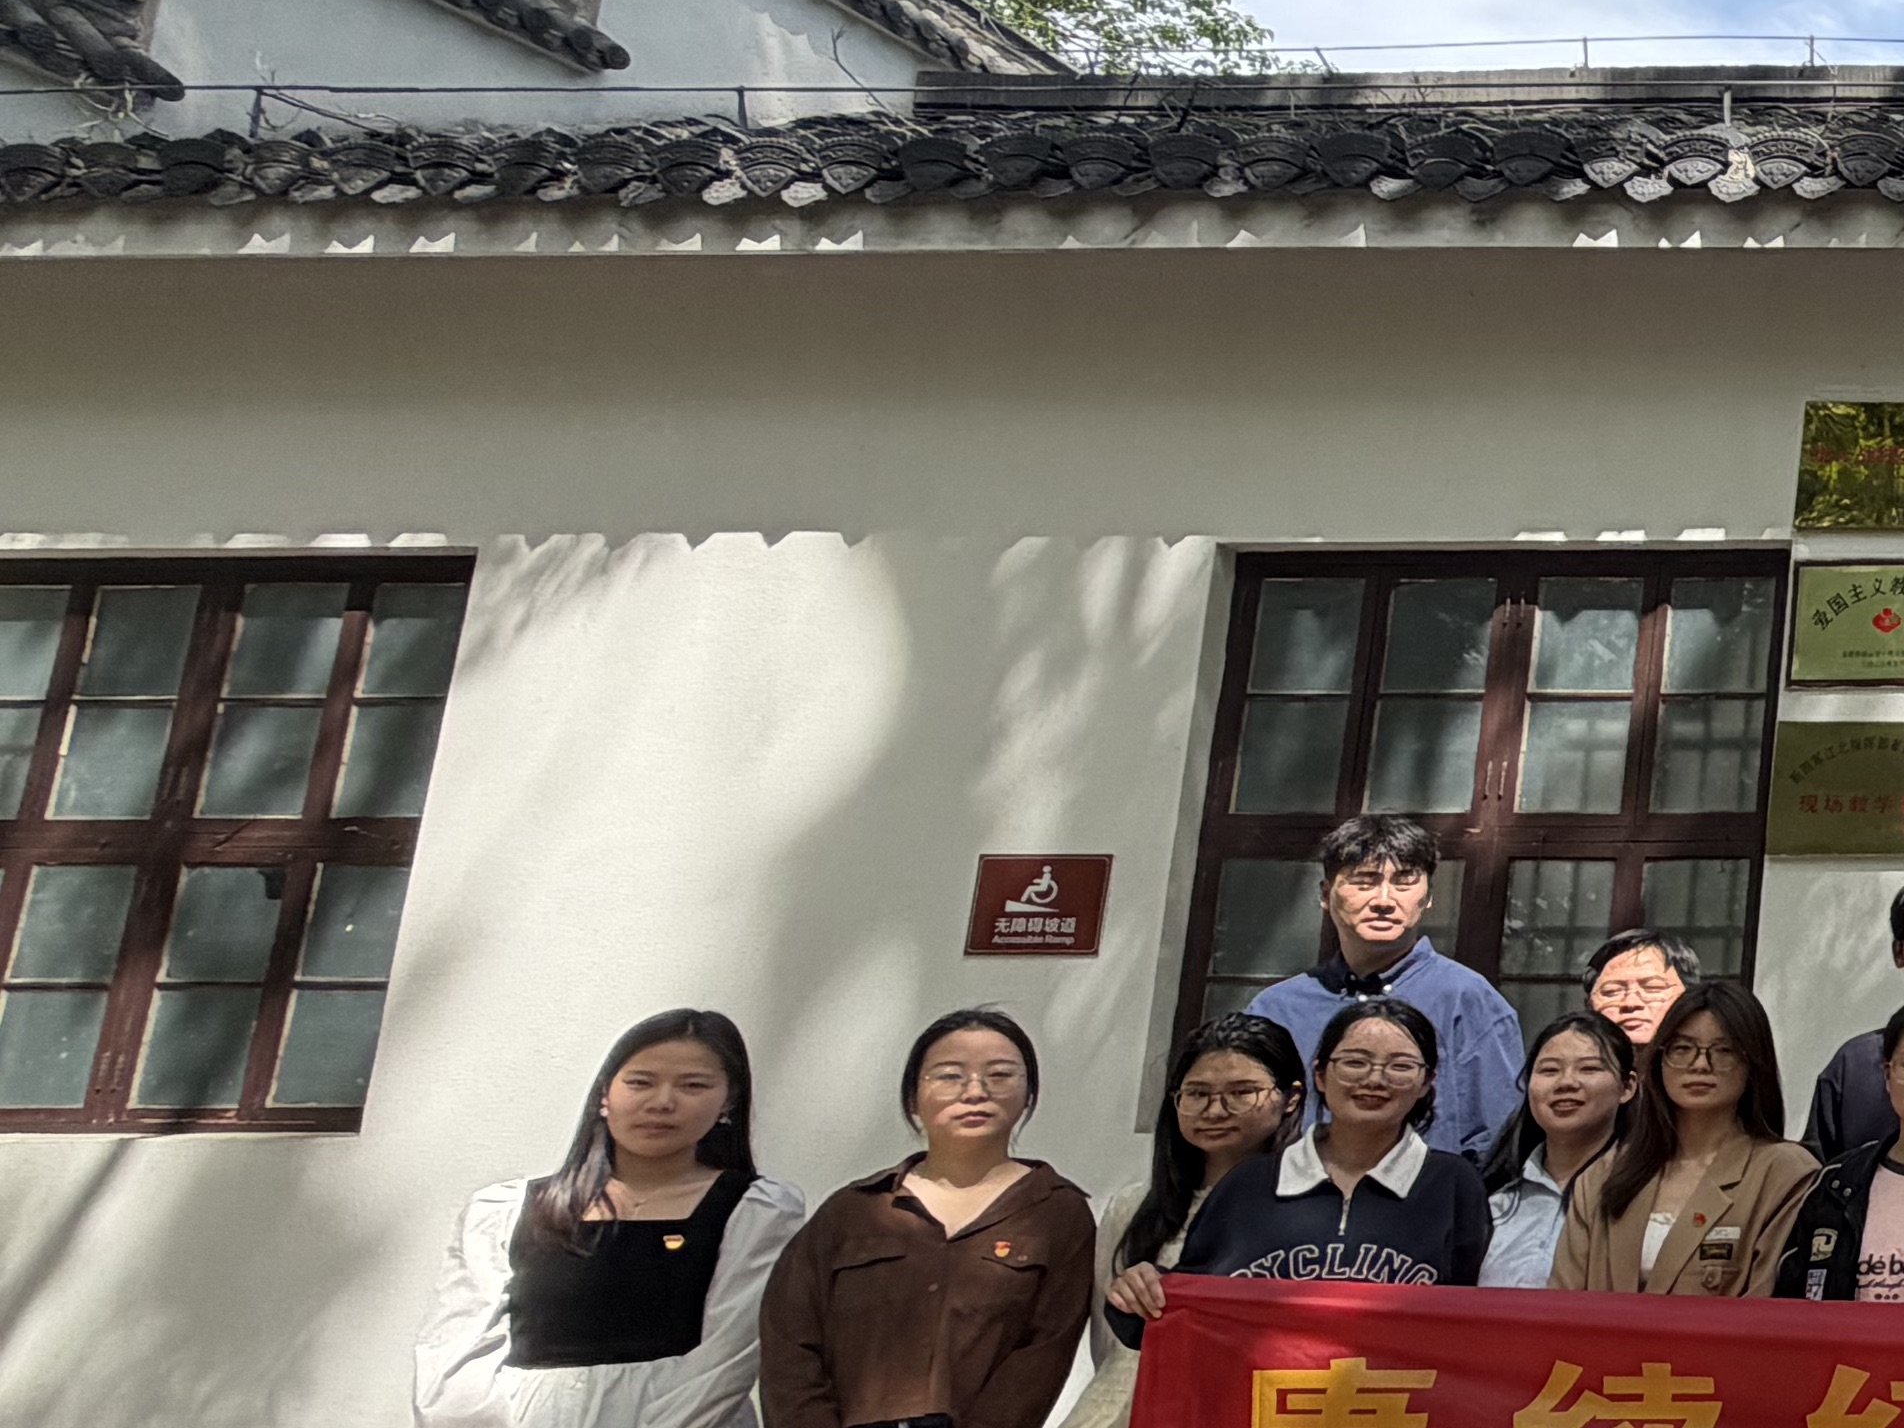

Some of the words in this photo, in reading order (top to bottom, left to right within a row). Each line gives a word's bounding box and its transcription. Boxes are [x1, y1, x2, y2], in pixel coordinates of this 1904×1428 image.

[994, 917, 1076, 933] 无障碍坡道
[1045, 935, 1075, 945] Ramp
[1229, 1243, 1438, 1285] YCLING
